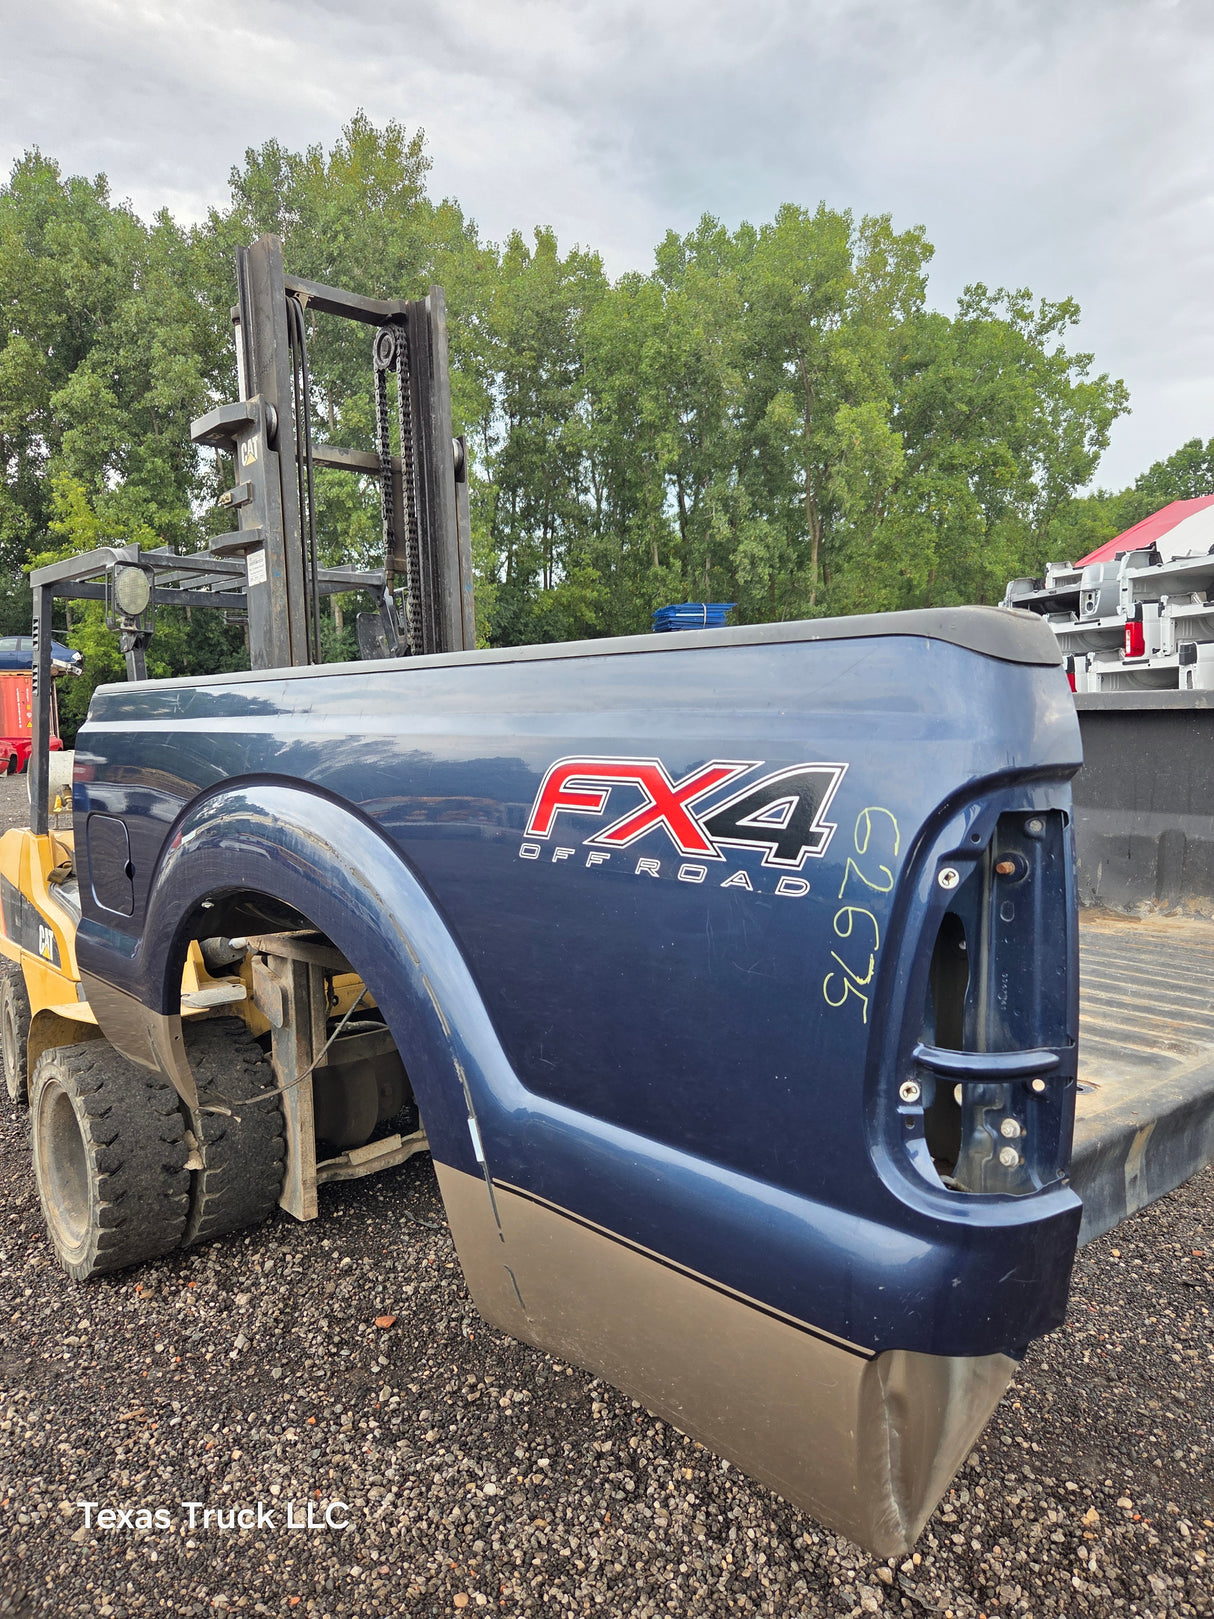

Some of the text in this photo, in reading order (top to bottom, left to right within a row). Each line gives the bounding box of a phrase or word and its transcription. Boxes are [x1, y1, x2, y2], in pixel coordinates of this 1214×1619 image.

[241, 435, 258, 466] CAT
[523, 755, 849, 871] FX4
[518, 842, 811, 897] OFF ROAD
[38, 924, 54, 961] CAT
[823, 806, 900, 1024] 62675
